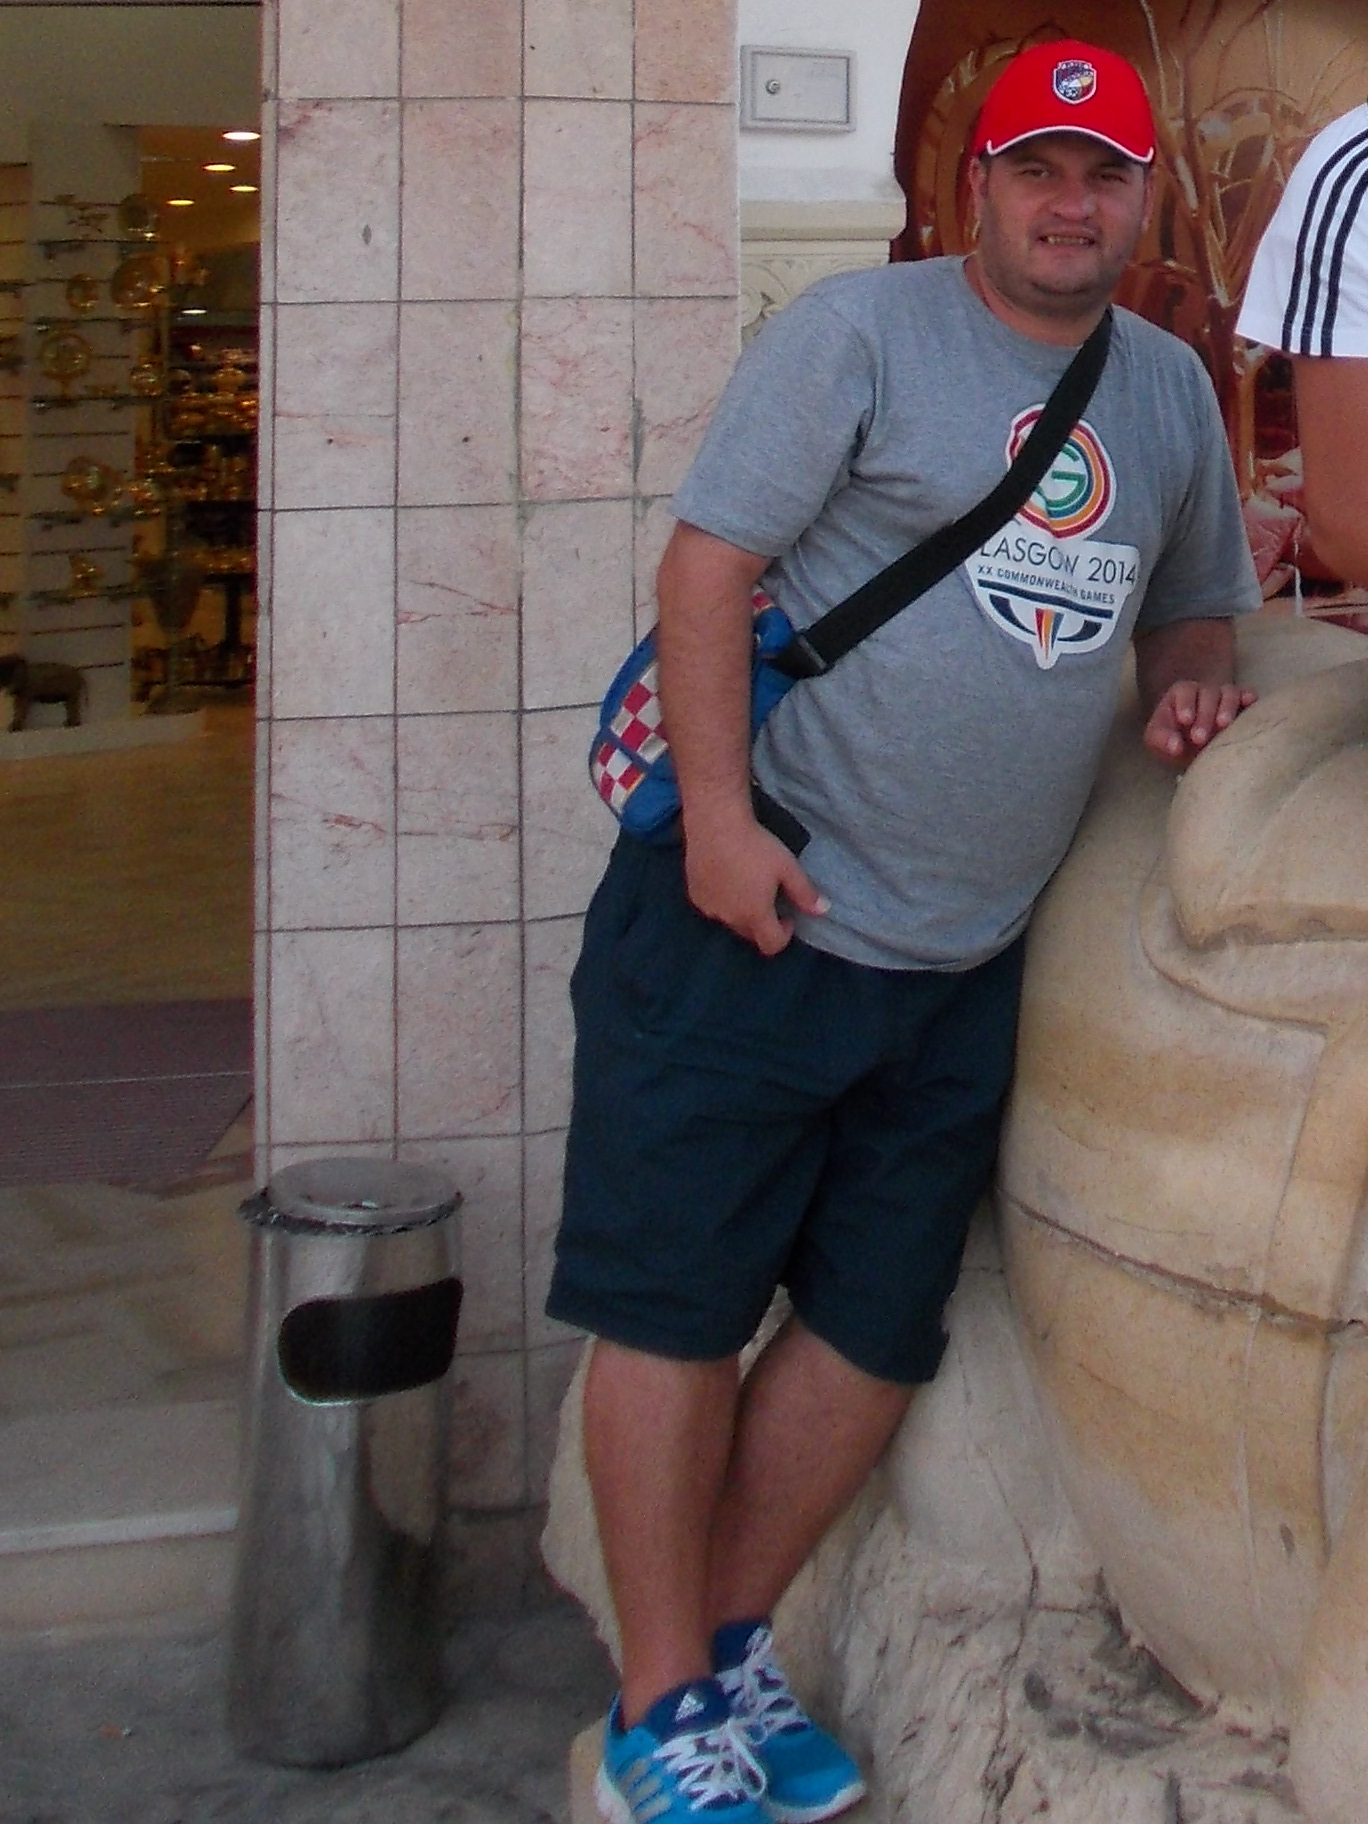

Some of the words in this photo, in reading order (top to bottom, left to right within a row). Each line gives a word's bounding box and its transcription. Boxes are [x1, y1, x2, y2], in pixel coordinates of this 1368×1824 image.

[979, 536, 1080, 576] LASGOW
[1087, 556, 1137, 586] 2014
[977, 564, 993, 576] XX
[1079, 588, 1116, 605] GAMES
